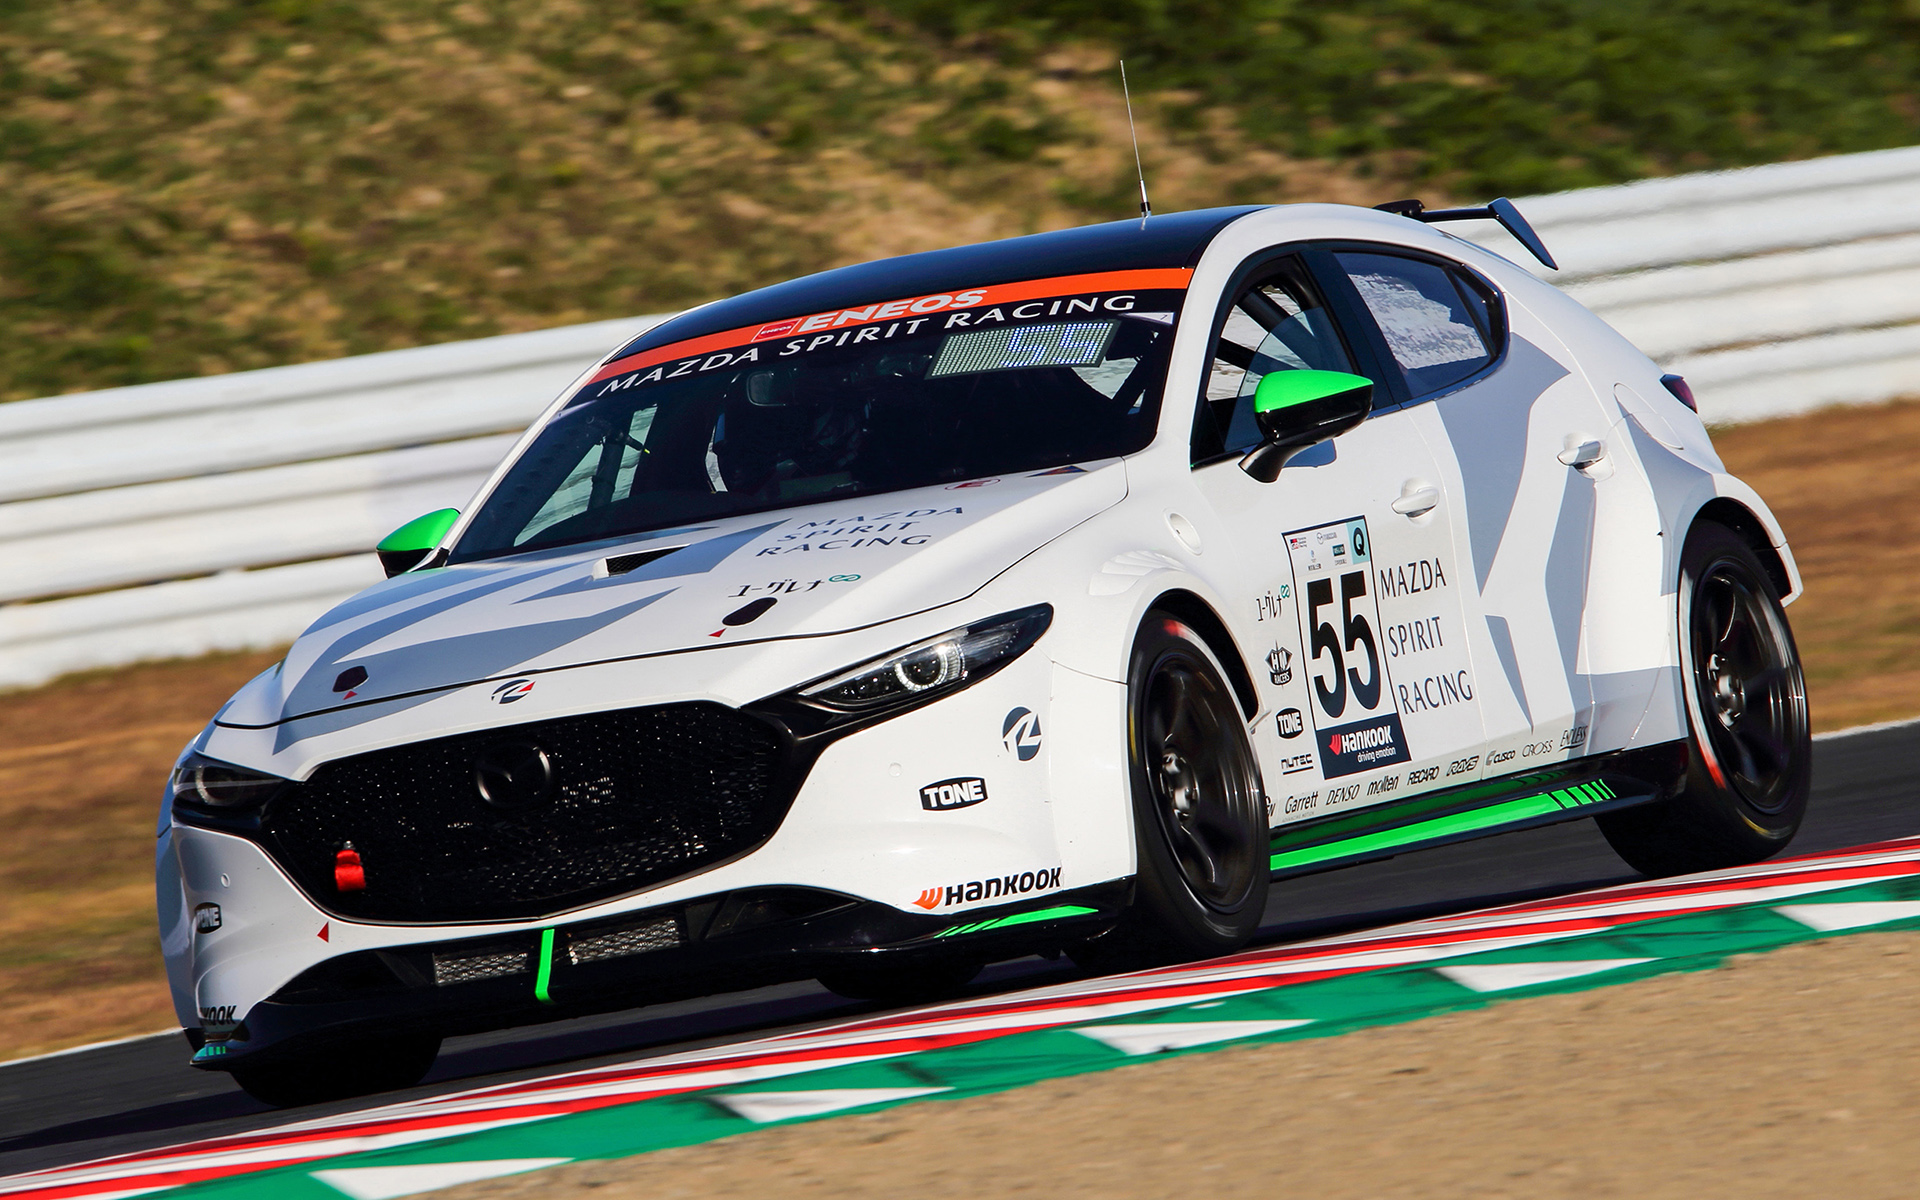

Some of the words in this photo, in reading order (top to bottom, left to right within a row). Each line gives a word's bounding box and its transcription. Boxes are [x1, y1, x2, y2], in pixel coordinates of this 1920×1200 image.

[798, 289, 988, 332] ENEOS
[760, 324, 792, 335] ENEOS
[999, 322, 1108, 368] 55
[597, 347, 760, 397] MAZDA
[779, 318, 930, 356] SPIRIT
[945, 295, 1137, 328] RACING
[777, 521, 920, 543] SPIRIT
[798, 506, 964, 529] MAZDA
[756, 534, 932, 556] RACING
[1353, 526, 1366, 557] Q
[728, 577, 825, 598] ユーグレナ
[1380, 557, 1447, 599] MAZDA
[1306, 570, 1382, 719] 55
[1388, 616, 1444, 658] SPIRIT
[1398, 668, 1474, 715] RACING
[1277, 711, 1303, 735] TONE
[1376, 746, 1397, 759] emotion
[1284, 791, 1319, 815] Garrett
[1326, 784, 1361, 806] DENSO
[1367, 773, 1400, 796] molten
[1407, 766, 1440, 786] RECARO
[1446, 755, 1479, 777] RAYS
[1522, 740, 1553, 758] CROSS
[924, 780, 984, 808] TONE
